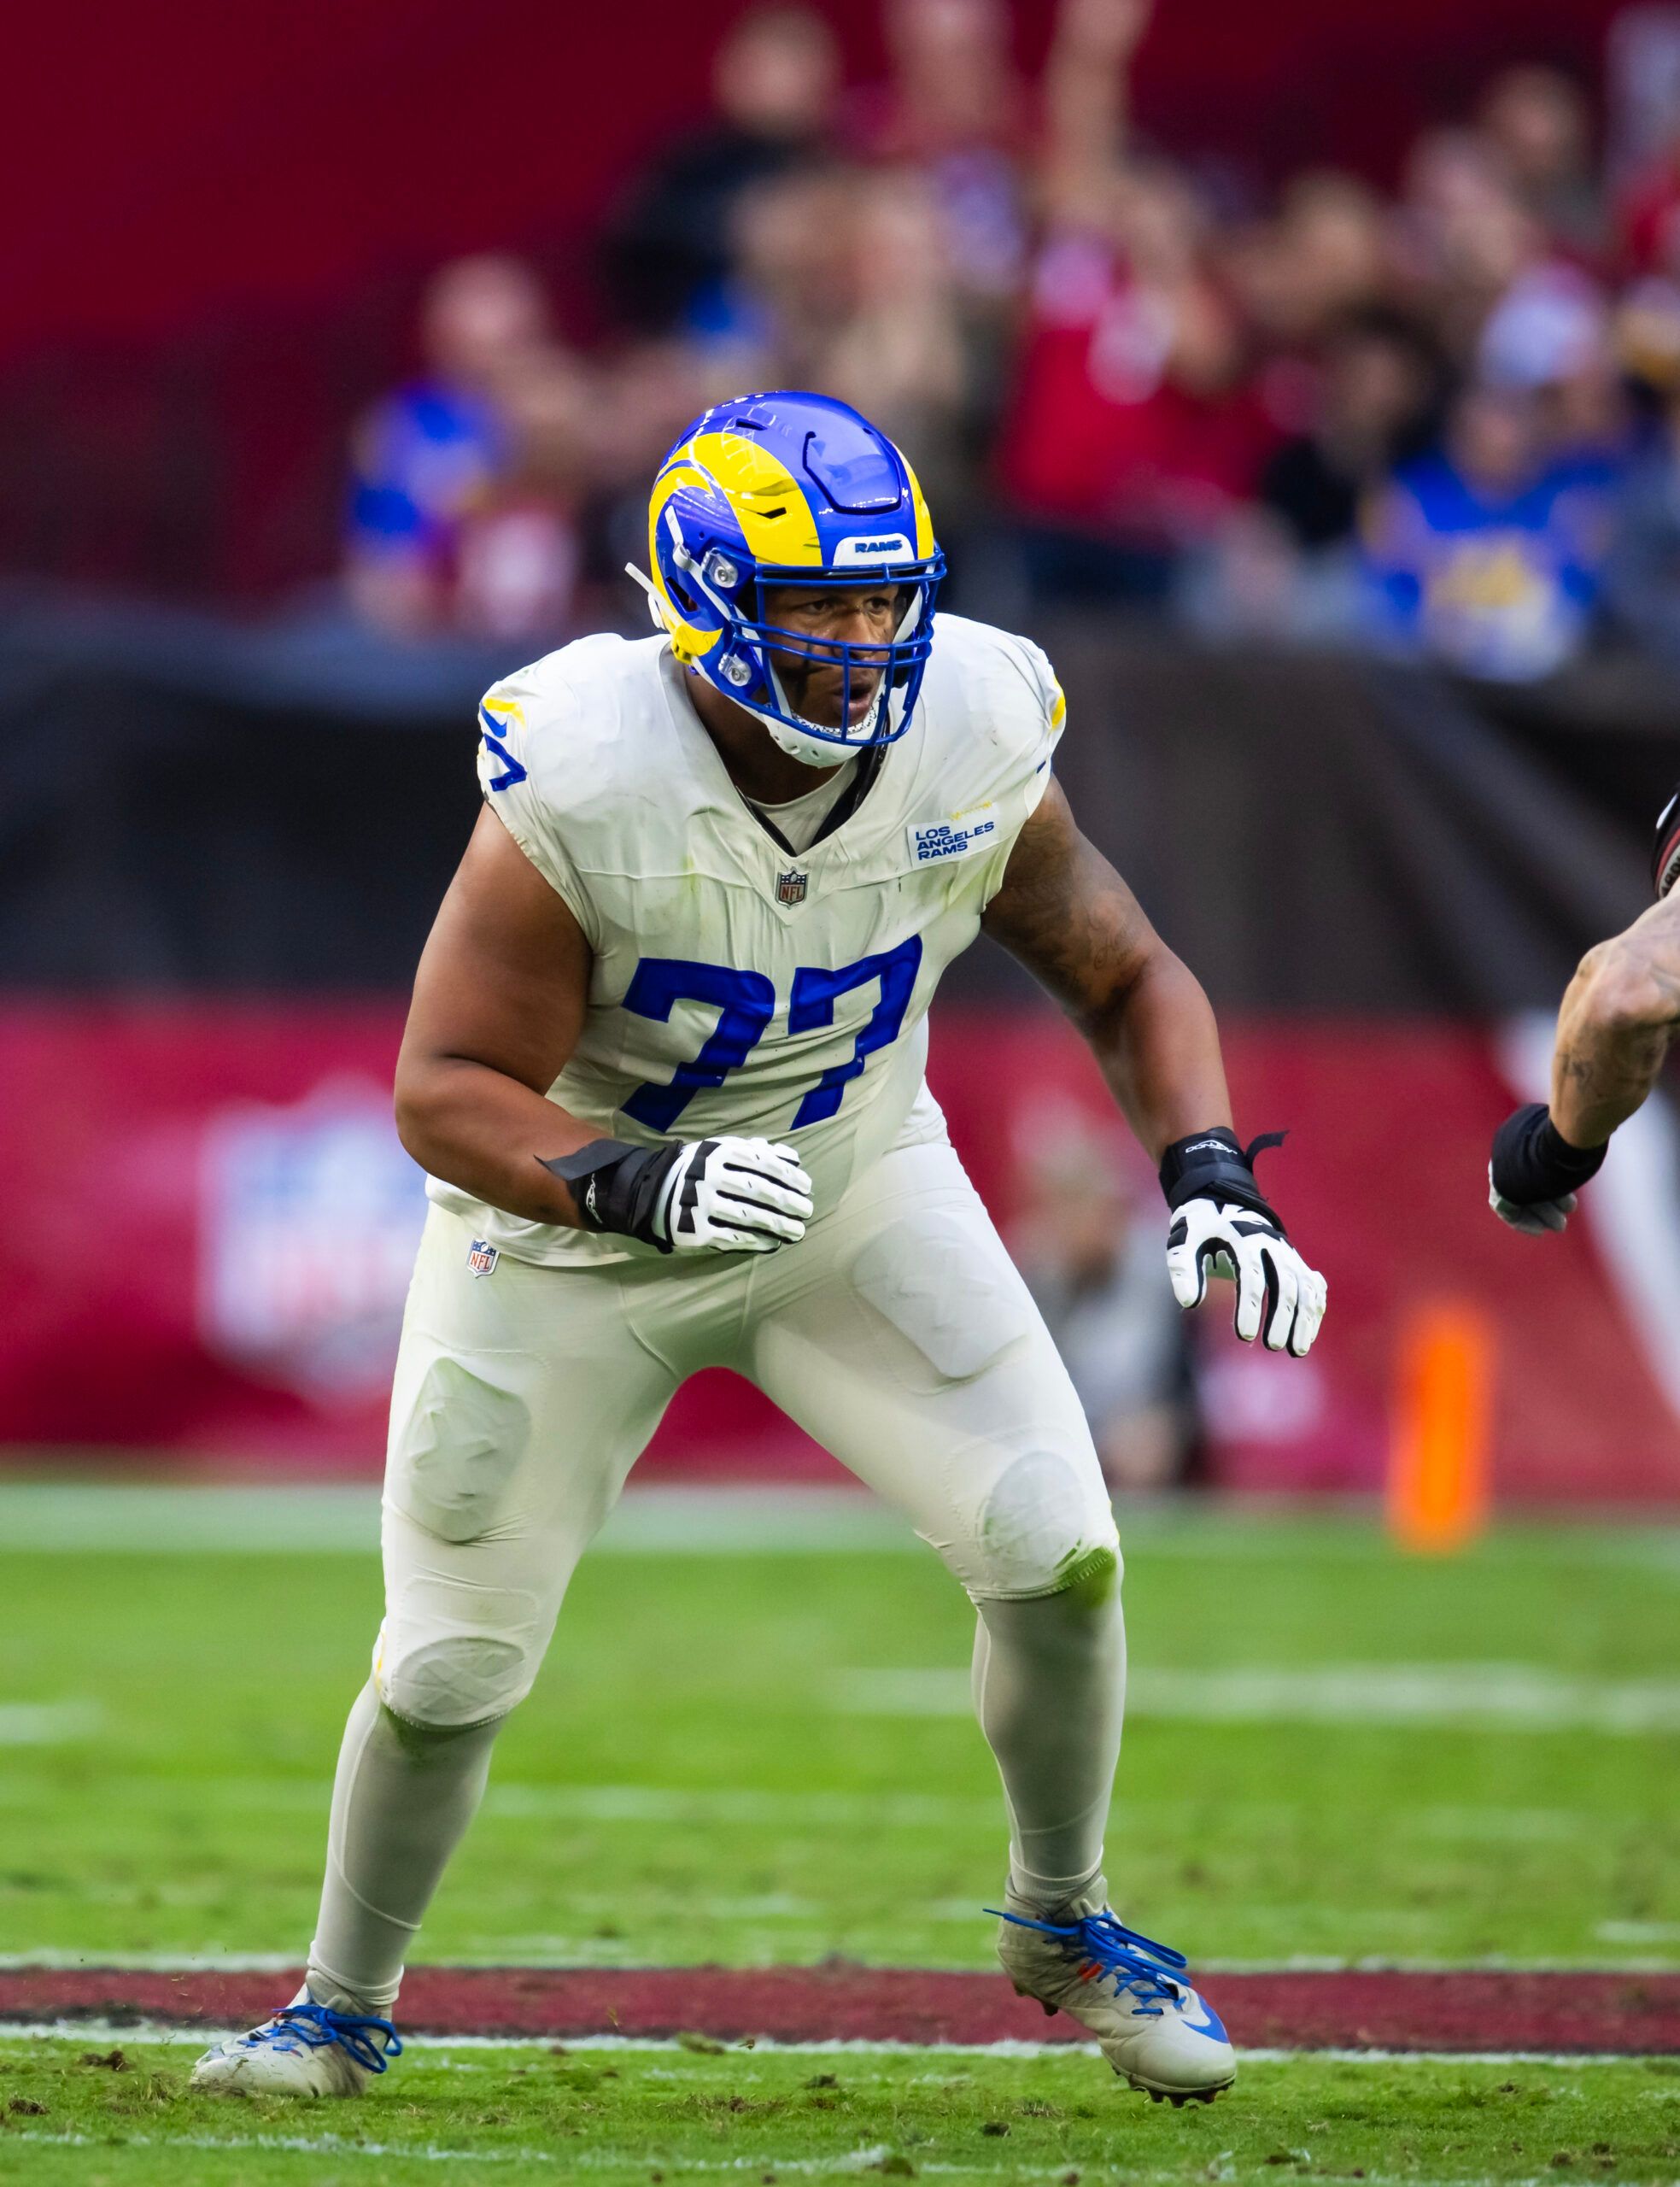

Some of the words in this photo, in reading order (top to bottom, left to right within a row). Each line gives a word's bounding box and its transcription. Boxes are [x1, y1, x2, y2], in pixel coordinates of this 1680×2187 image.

[855, 539, 903, 553] RAMS
[916, 826, 951, 841] LOS
[917, 821, 995, 851] ANGELES
[918, 841, 968, 860] RAMS
[781, 886, 803, 902] NFL
[620, 933, 923, 1133] 77
[470, 1252, 491, 1270] NFL
